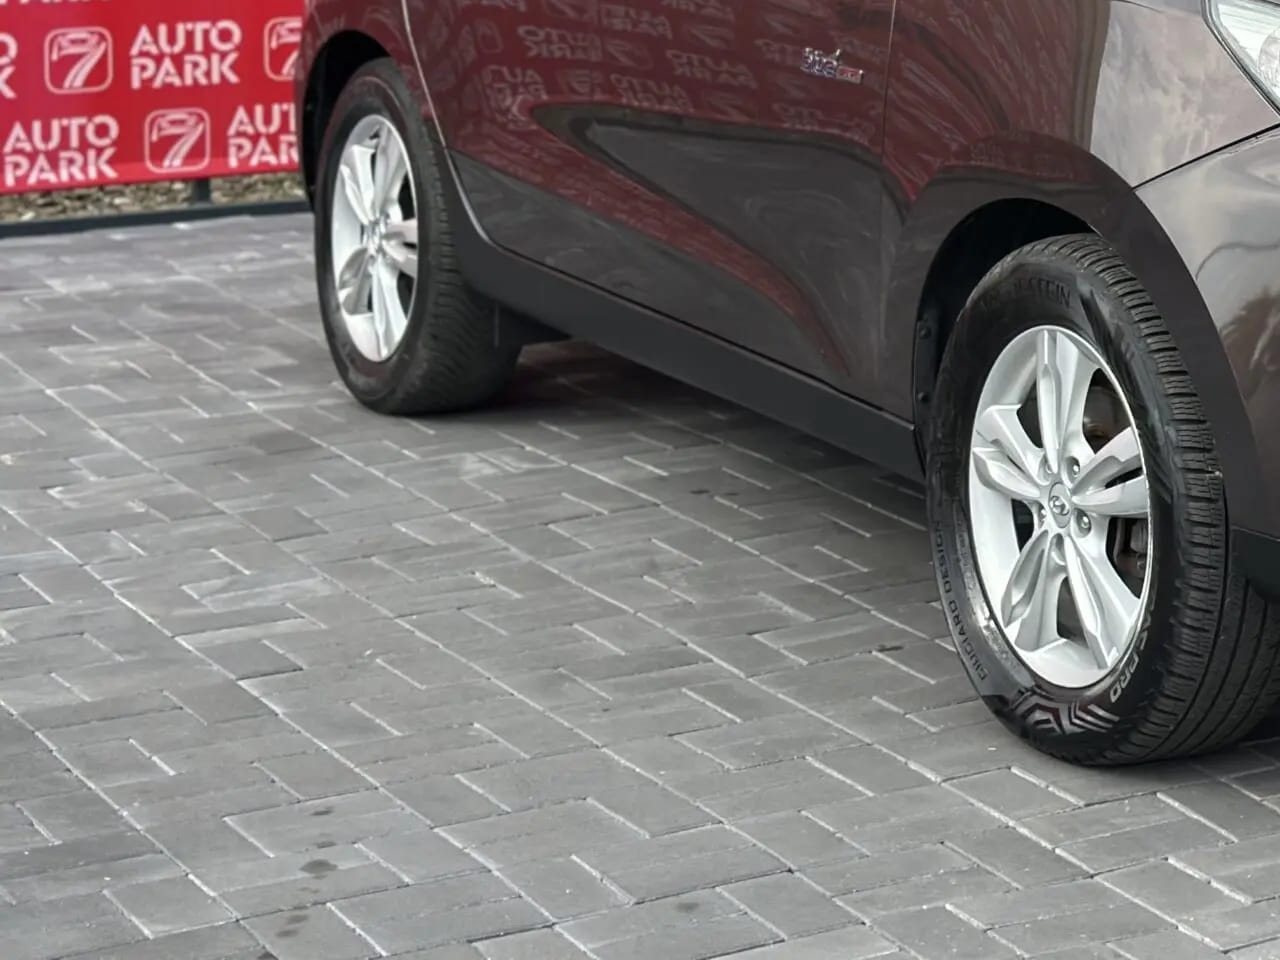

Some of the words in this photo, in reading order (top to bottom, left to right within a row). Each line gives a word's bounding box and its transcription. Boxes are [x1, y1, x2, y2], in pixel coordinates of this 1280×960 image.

[130, 20, 241, 56] AUTO
[132, 52, 238, 89] PARK
[3, 115, 118, 152] AUTO
[228, 134, 299, 168] PAR
[4, 148, 118, 186] PARK
